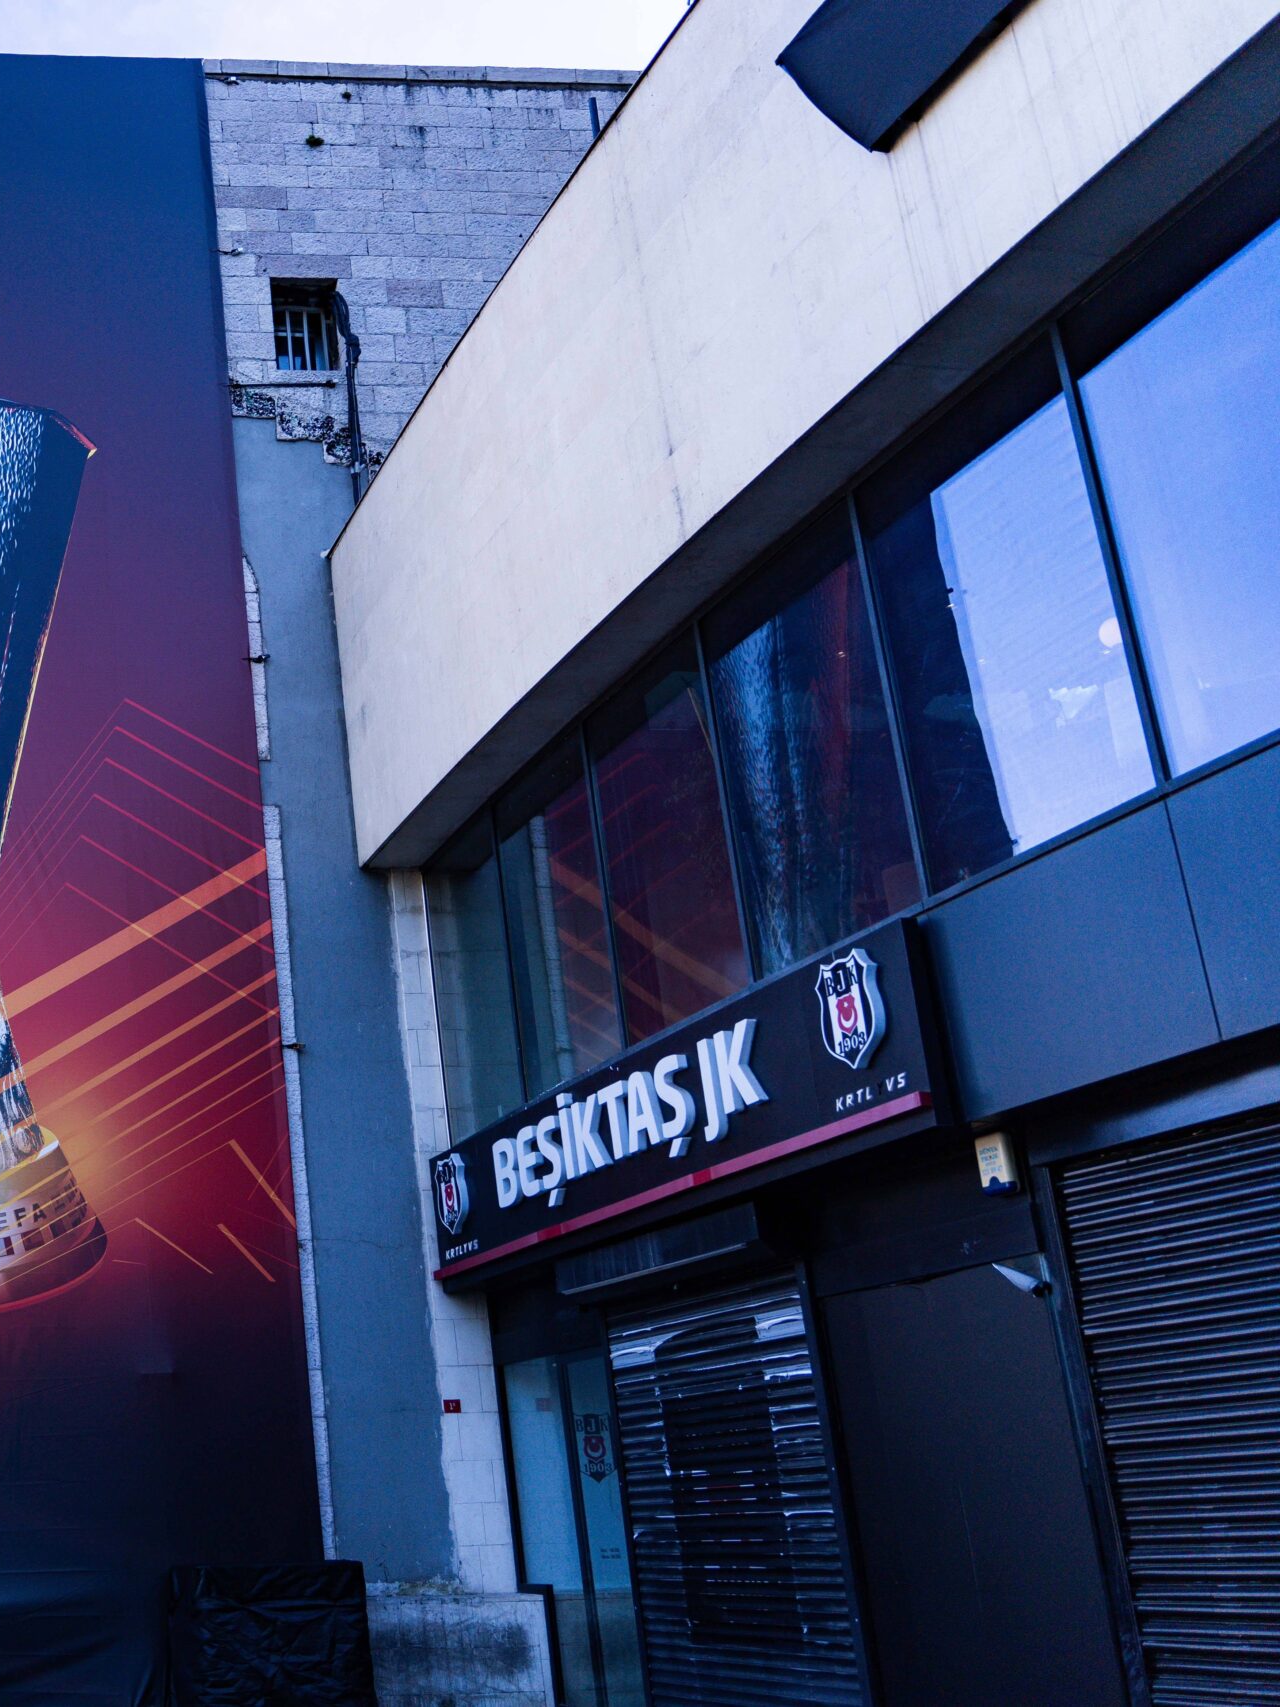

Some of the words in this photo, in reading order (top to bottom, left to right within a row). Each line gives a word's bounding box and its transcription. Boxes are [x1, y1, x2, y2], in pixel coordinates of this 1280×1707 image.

[825, 962, 859, 997] BJK
[837, 1031, 867, 1057] 1903
[835, 1072, 907, 1112] KRTLYVS
[491, 1053, 696, 1209] BEŞİKTAŞ
[696, 1018, 769, 1142] JK
[445, 1239, 479, 1260] KRTLYVS
[575, 1417, 609, 1433] BJK
[583, 1462, 615, 1475] 1903
